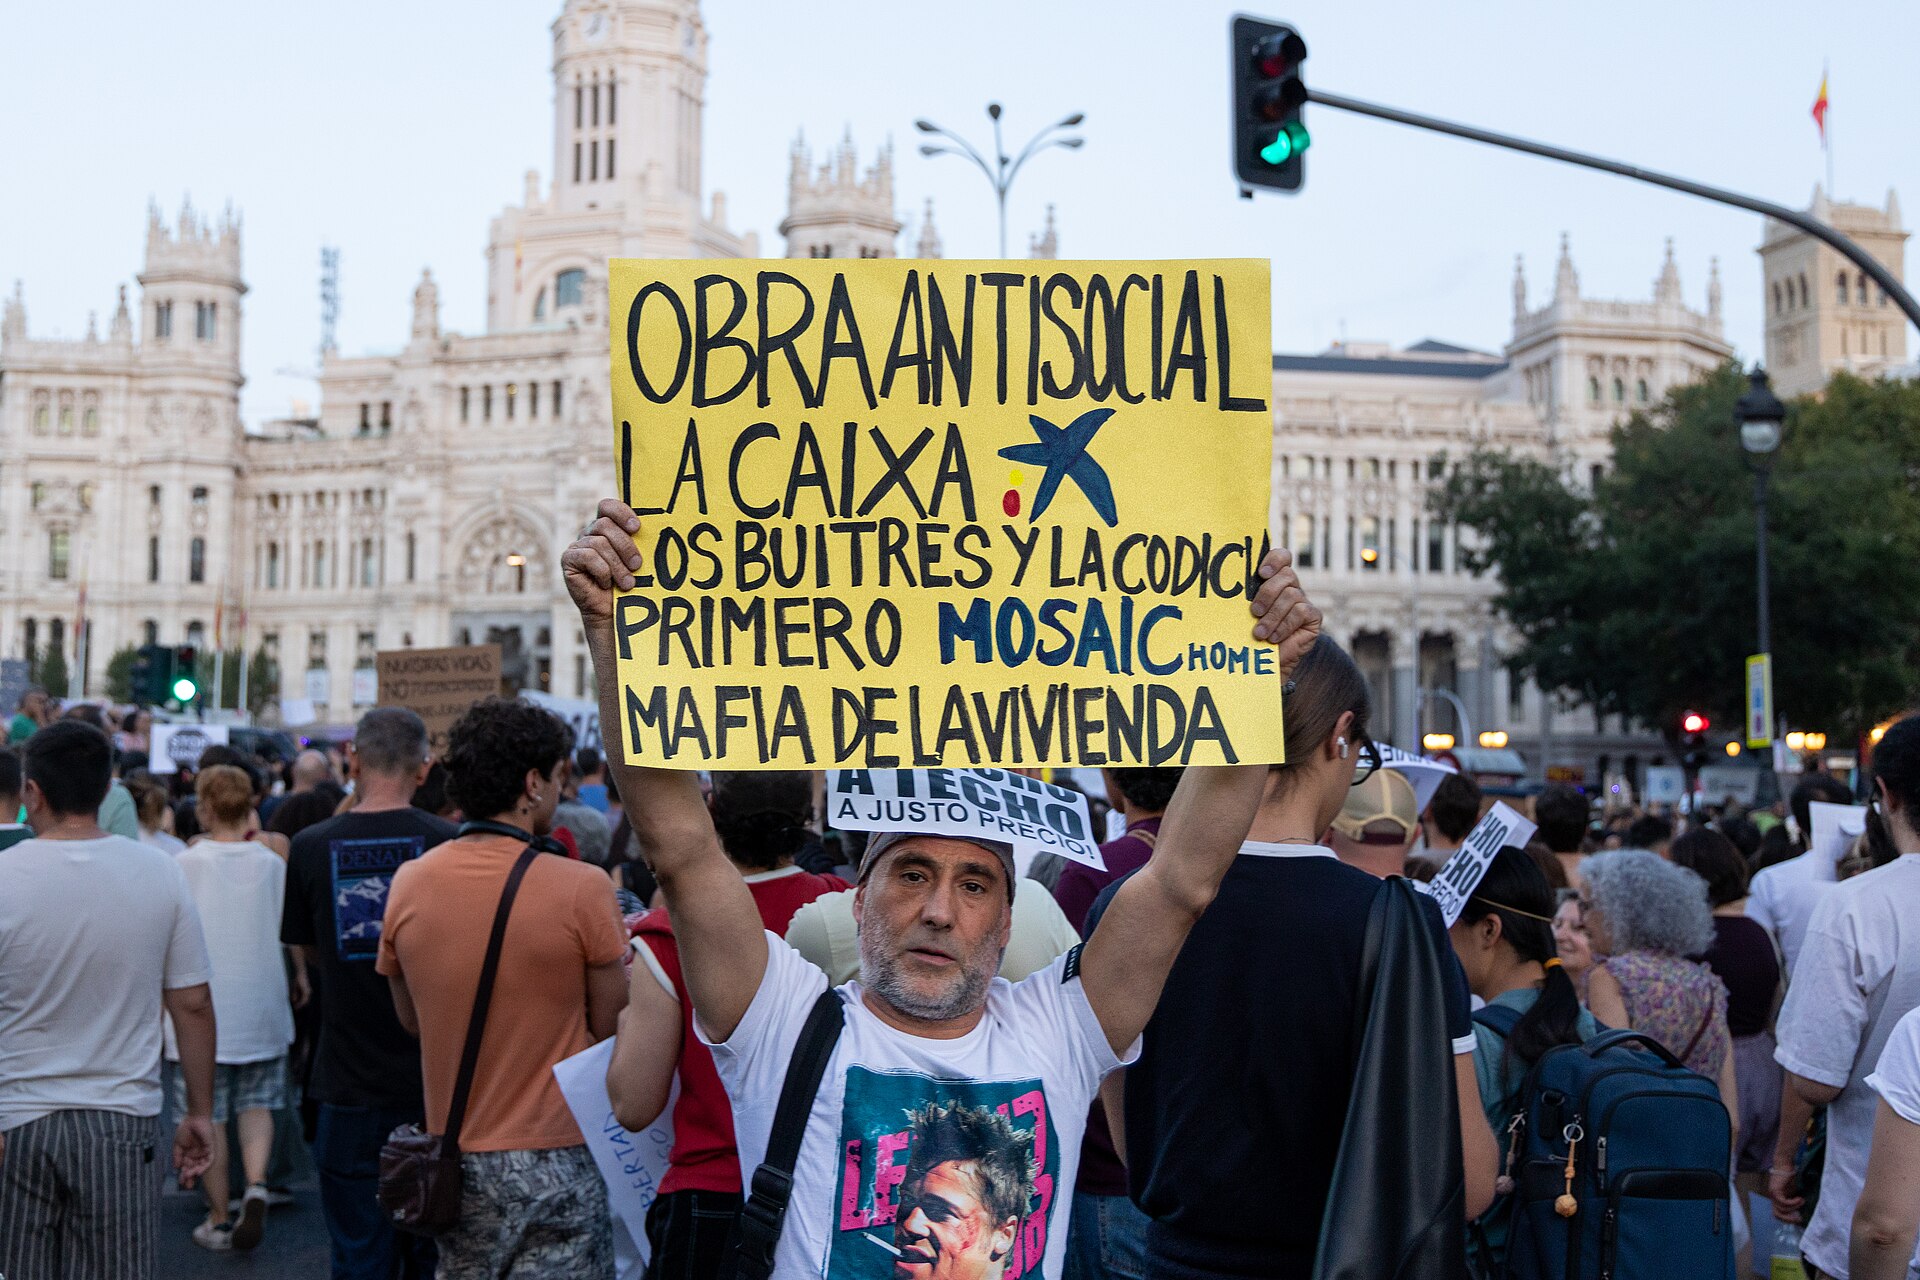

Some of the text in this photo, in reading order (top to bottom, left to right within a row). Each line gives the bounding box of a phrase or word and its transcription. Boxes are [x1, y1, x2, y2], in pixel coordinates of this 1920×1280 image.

[627, 268, 1267, 412] OBRA ANTISOCIAL
[622, 416, 978, 522] LA CAIXA
[735, 517, 992, 592] BUITRES
[1001, 524, 1041, 588] Y
[1050, 525, 1107, 592] LA
[616, 595, 1276, 676] PRIMERO MOSAIC HOME
[625, 683, 817, 765] MAFIA
[832, 686, 900, 768] DE
[909, 684, 982, 768] LA
[971, 682, 1241, 767] VIVIENDA
[837, 797, 1095, 860] A JUSTO PRECIO!
